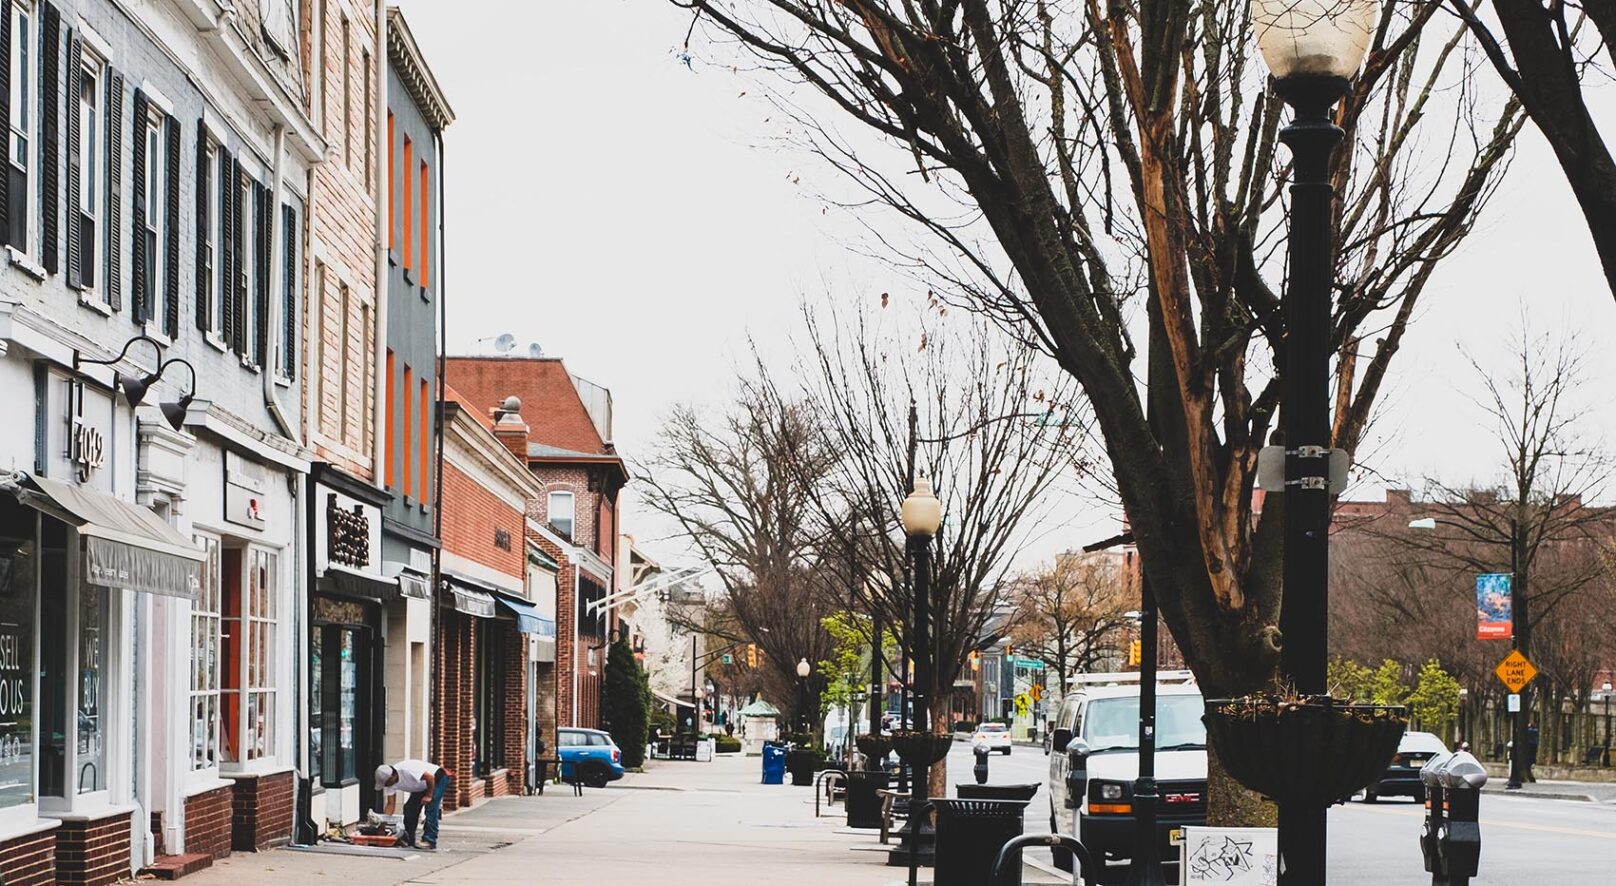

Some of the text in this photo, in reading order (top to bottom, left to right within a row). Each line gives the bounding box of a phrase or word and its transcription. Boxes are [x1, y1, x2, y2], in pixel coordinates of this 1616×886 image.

[0, 635, 20, 670] SELL
[86, 637, 99, 668] WE
[0, 675, 23, 715] O US
[84, 676, 100, 709] BUY
[1165, 793, 1199, 803] GMC
